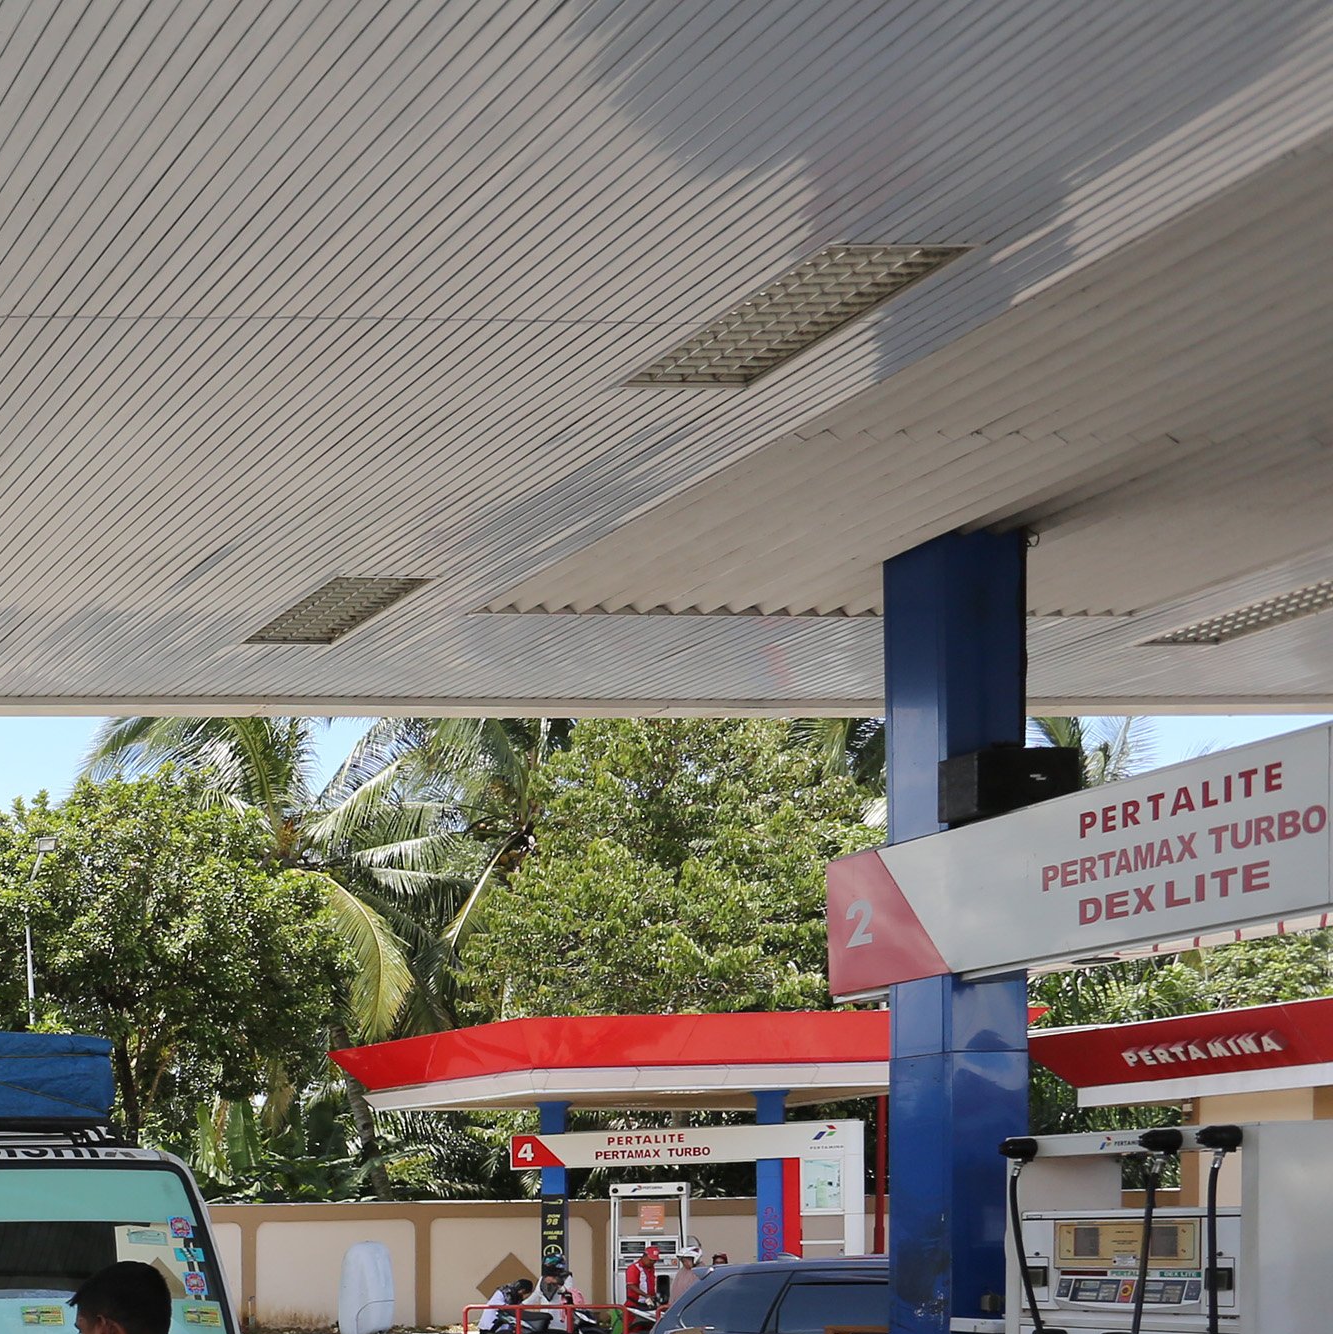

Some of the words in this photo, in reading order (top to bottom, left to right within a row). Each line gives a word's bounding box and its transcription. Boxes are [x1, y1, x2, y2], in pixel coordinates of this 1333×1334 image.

[1080, 761, 1282, 839] PERTALITE
[1041, 831, 1198, 892] PERTAMAX
[1208, 804, 1327, 854] TURBO
[845, 899, 874, 949] 2
[1121, 1033, 1283, 1067] PERTAMINA
[517, 1143, 534, 1162] 4
[595, 1149, 661, 1161] PERTAMAX
[667, 1146, 711, 1157] TURBO
[607, 1133, 685, 1146] PERTALITE
